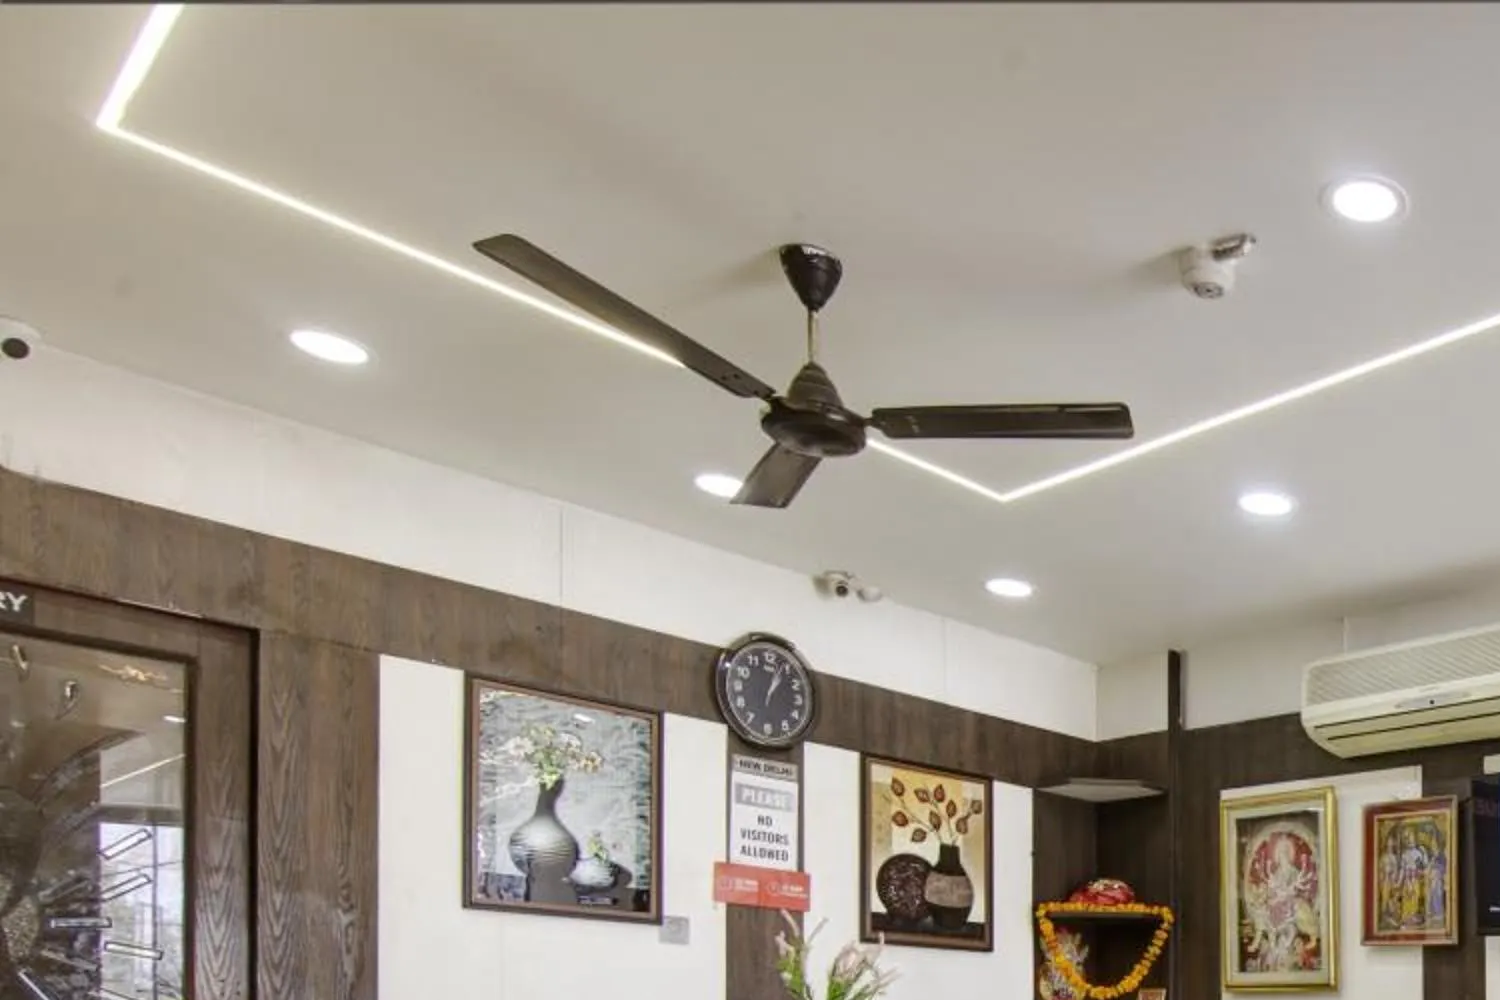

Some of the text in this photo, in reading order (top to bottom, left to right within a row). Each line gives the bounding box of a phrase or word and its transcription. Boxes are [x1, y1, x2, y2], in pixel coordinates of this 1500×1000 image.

[757, 814, 773, 827] NO
[740, 828, 789, 846] VISITORS
[740, 845, 789, 863] ALLOWED
